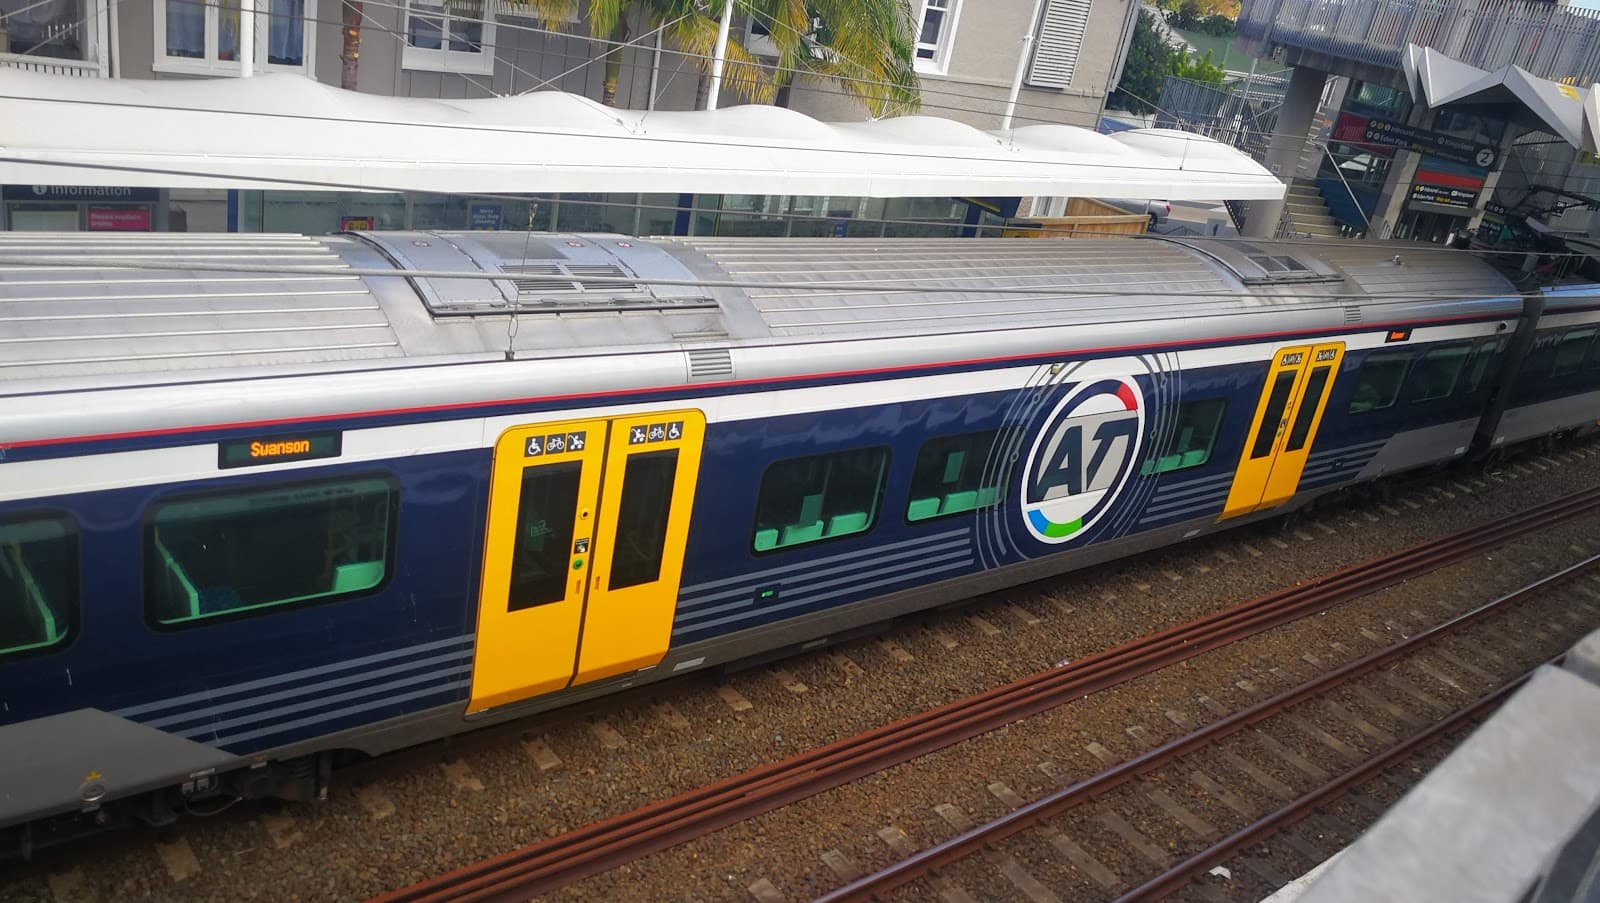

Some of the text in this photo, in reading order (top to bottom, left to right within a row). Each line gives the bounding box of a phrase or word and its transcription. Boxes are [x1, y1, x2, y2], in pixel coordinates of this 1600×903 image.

[1480, 152, 1490, 163] 2
[51, 184, 131, 196] Information
[250, 440, 310, 457] Swanson
[1027, 417, 1139, 504] AT
